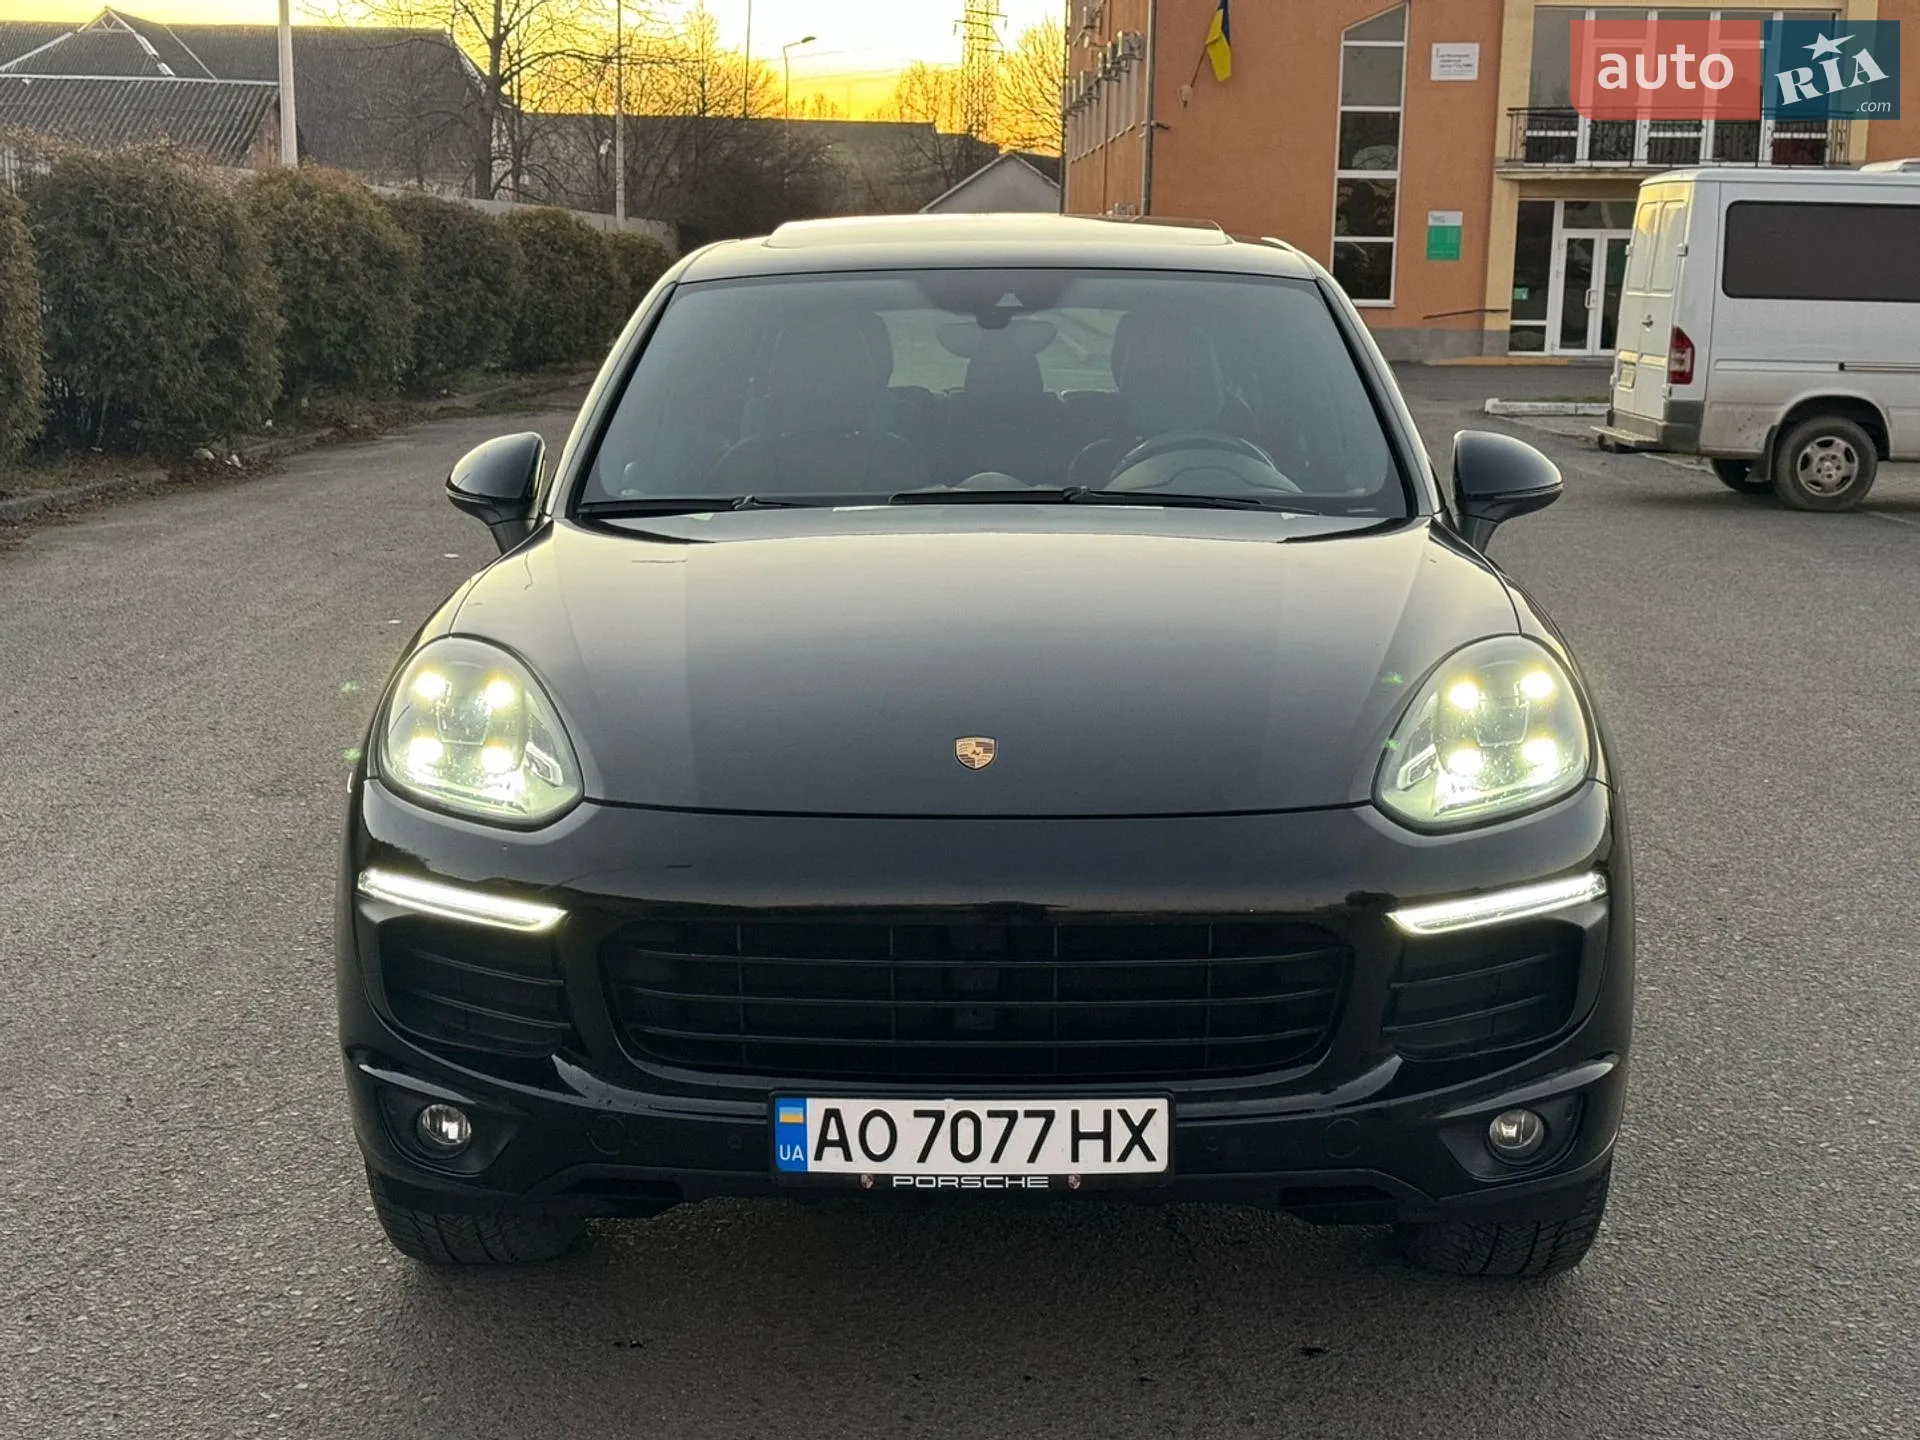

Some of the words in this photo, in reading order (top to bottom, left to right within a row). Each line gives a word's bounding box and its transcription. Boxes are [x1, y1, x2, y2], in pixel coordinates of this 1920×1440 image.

[814, 1108, 897, 1163] AO
[913, 1109, 1056, 1163] 7077
[1071, 1108, 1157, 1163] HX
[779, 1144, 804, 1161] UA
[893, 1176, 1049, 1188] PORSCHE
